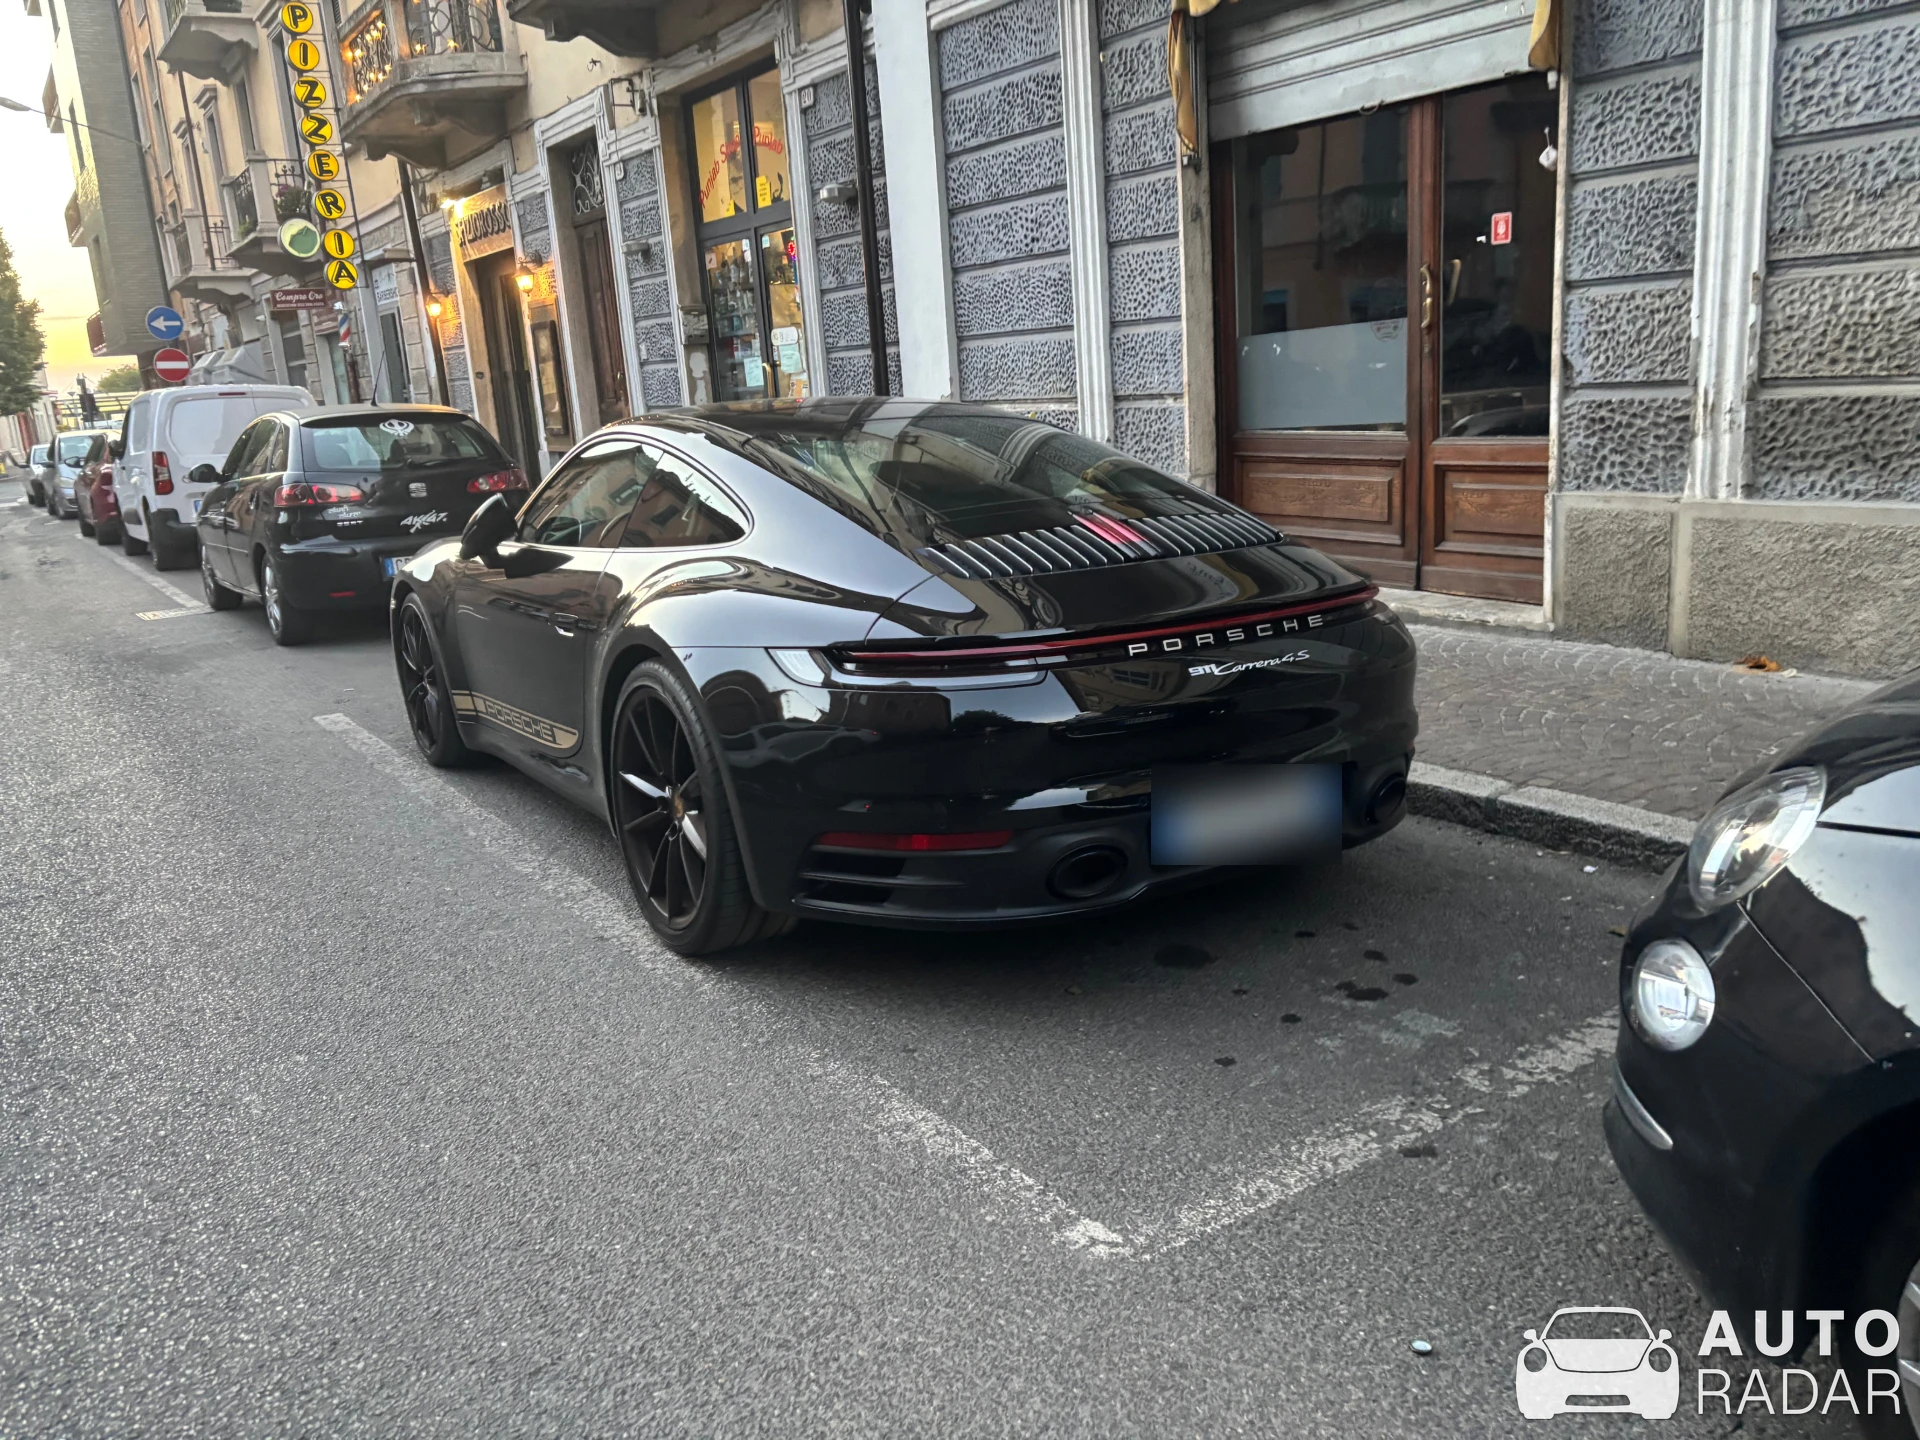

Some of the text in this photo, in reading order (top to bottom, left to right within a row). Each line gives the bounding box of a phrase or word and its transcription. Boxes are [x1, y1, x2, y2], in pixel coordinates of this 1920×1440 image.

[288, 5, 356, 284] PIZZERIA
[274, 291, 324, 303] Compro Oro
[1128, 614, 1324, 657] PORSCHE
[1213, 658, 1281, 676] Carrera
[485, 700, 554, 742] PORSCHE
